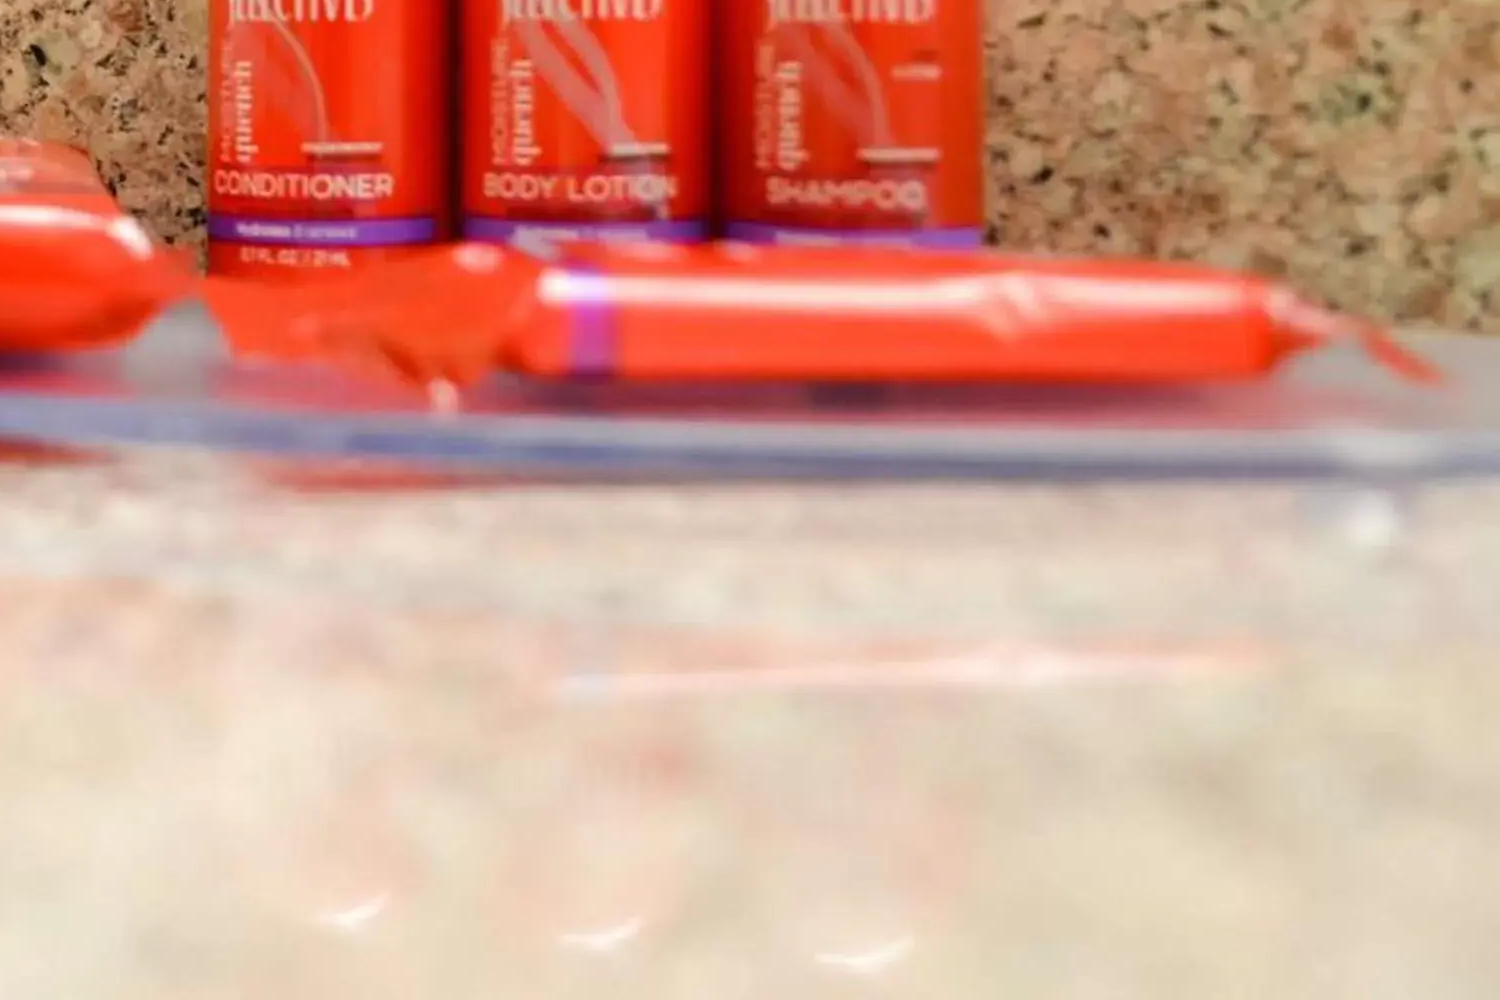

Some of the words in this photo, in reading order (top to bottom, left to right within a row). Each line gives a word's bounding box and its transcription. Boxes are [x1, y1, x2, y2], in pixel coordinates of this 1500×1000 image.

[510, 58, 542, 167] quench
[214, 171, 395, 200] CONDITIONER
[484, 172, 558, 200] BODY
[566, 174, 678, 202] LOTION
[766, 176, 929, 211] SHAMPOO
